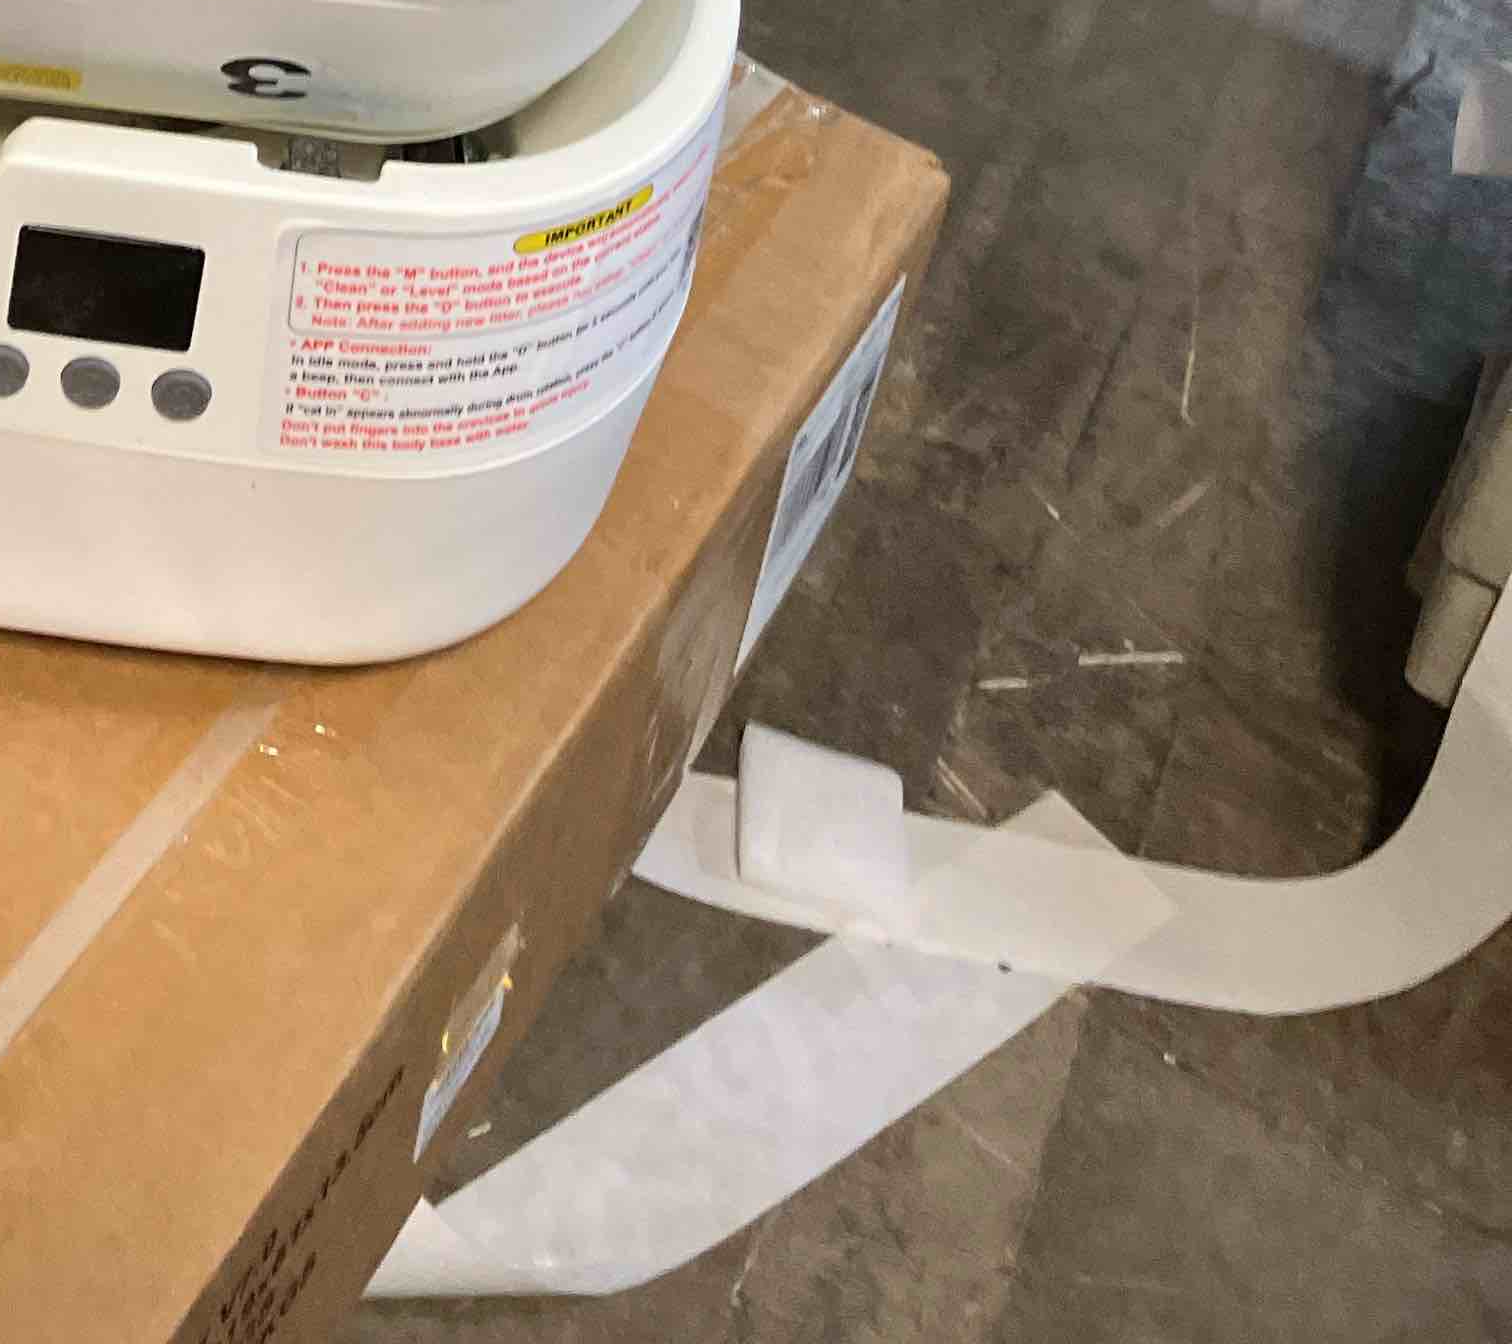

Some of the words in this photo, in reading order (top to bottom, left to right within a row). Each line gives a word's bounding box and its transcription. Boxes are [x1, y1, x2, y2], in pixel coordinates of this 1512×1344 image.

[219, 58, 311, 99] 3
[544, 199, 632, 246] IMPORTANT
[317, 260, 361, 277] Press
[367, 264, 392, 279] the
[430, 263, 482, 280] button,
[488, 259, 515, 274] and
[519, 256, 540, 272] the
[544, 243, 585, 263] device
[314, 295, 352, 310] Then
[356, 301, 399, 316] press
[405, 301, 429, 314] the
[464, 295, 511, 312] button
[533, 276, 581, 298] execute
[315, 280, 376, 295] "Clean"
[380, 285, 397, 296] or
[403, 284, 458, 298] "Level"
[463, 280, 503, 294] mode
[507, 270, 549, 289] based
[356, 315, 393, 330] After
[399, 318, 451, 333] adding
[455, 316, 486, 329] new
[301, 338, 335, 352] APP
[339, 339, 432, 356] Connection:
[309, 355, 334, 368] idle
[338, 358, 381, 371] mode,
[384, 360, 424, 374] press
[427, 357, 452, 369] and
[456, 353, 486, 367] hold
[489, 349, 509, 362] the
[536, 330, 573, 352] button
[302, 369, 339, 385] beep,
[345, 372, 375, 385] then
[379, 374, 435, 386] connect
[438, 372, 466, 385] with
[469, 368, 489, 382] the
[493, 362, 519, 378] App
[296, 386, 348, 400] Button
[347, 406, 395, 420] appears
[399, 404, 464, 419] abnormally
[467, 398, 503, 413] during
[506, 389, 534, 405] drum
[280, 434, 317, 448] Don't
[321, 437, 358, 450] wash
[362, 437, 388, 450] this
[392, 438, 426, 452] body
[430, 435, 462, 449] base
[466, 429, 491, 444] with
[494, 419, 530, 438] water
[281, 418, 319, 433] Don't
[323, 422, 346, 435] put
[350, 422, 398, 437] fingers
[403, 422, 429, 434] into
[433, 420, 454, 433] the
[457, 411, 510, 430] crevices
